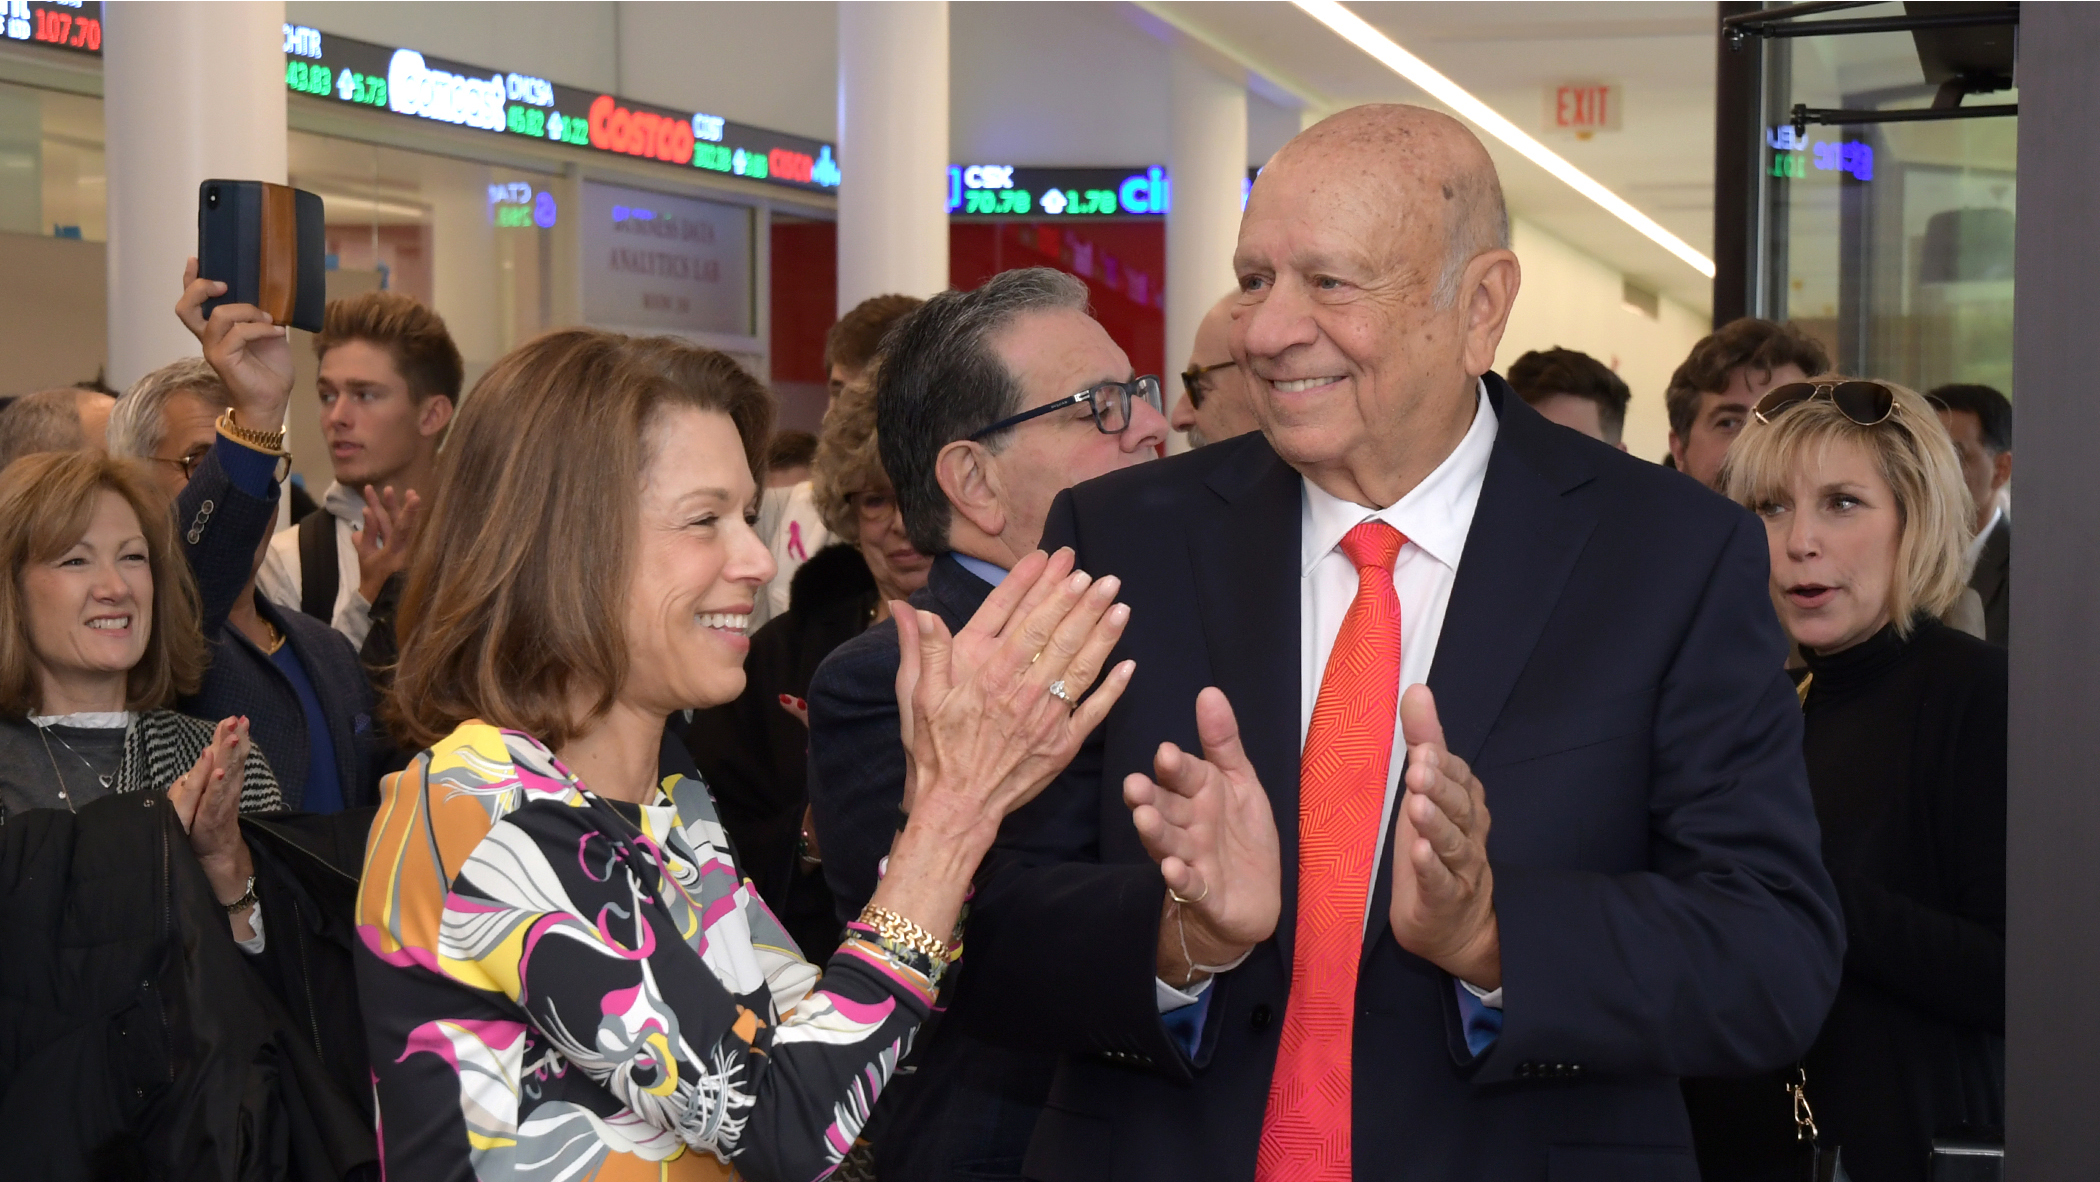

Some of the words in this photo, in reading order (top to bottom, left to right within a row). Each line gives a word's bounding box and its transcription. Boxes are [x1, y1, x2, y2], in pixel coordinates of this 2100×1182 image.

[35, 8, 101, 50] 107.70
[1556, 86, 1610, 127] EXIT
[964, 165, 1014, 189] CSX
[1119, 164, 1171, 214] ci
